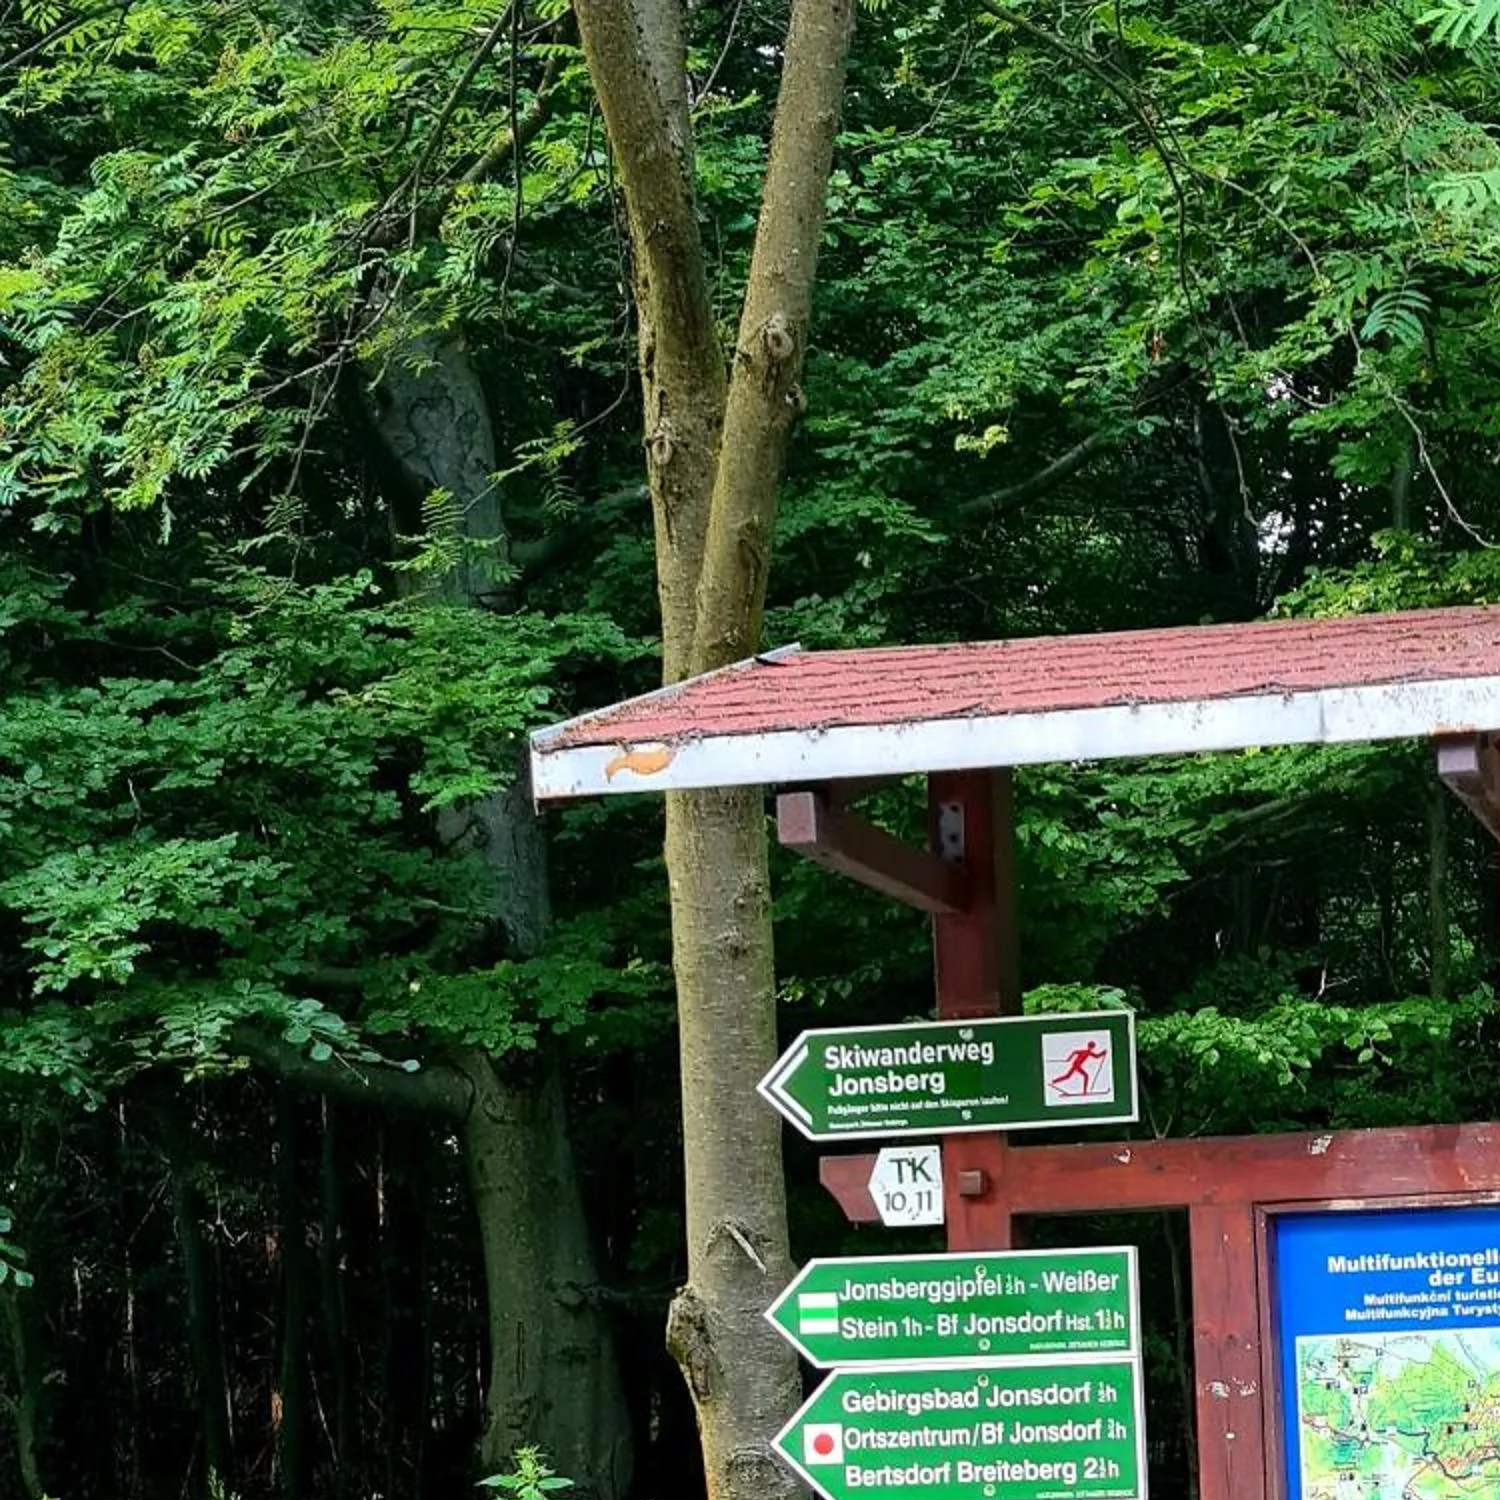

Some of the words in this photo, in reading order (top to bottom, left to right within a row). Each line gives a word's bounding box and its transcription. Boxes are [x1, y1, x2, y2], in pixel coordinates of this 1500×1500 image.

[824, 1041, 994, 1070] Skiwanderweg
[828, 1070, 946, 1097] Jonsberg
[889, 1157, 933, 1184] TK
[839, 1276, 1003, 1304] Jonsberggipfel
[1041, 1269, 1119, 1293] Weißer
[1429, 1270, 1465, 1287] der
[842, 1316, 897, 1340] Stein
[937, 1313, 959, 1336] Bf
[963, 1309, 1063, 1335] Jonsdorf
[1065, 1313, 1094, 1331] Hst.
[1345, 1306, 1449, 1321] Multifunkcyjna
[842, 1383, 979, 1416] Gebirgsbad
[986, 1381, 1091, 1408] Jonsdorf
[844, 1421, 1003, 1450] Ortszentrum/Bf
[1009, 1418, 1102, 1444] Jonsdorf
[845, 1461, 949, 1488] Bertsdorf
[957, 1458, 1077, 1486] Breiteberg
